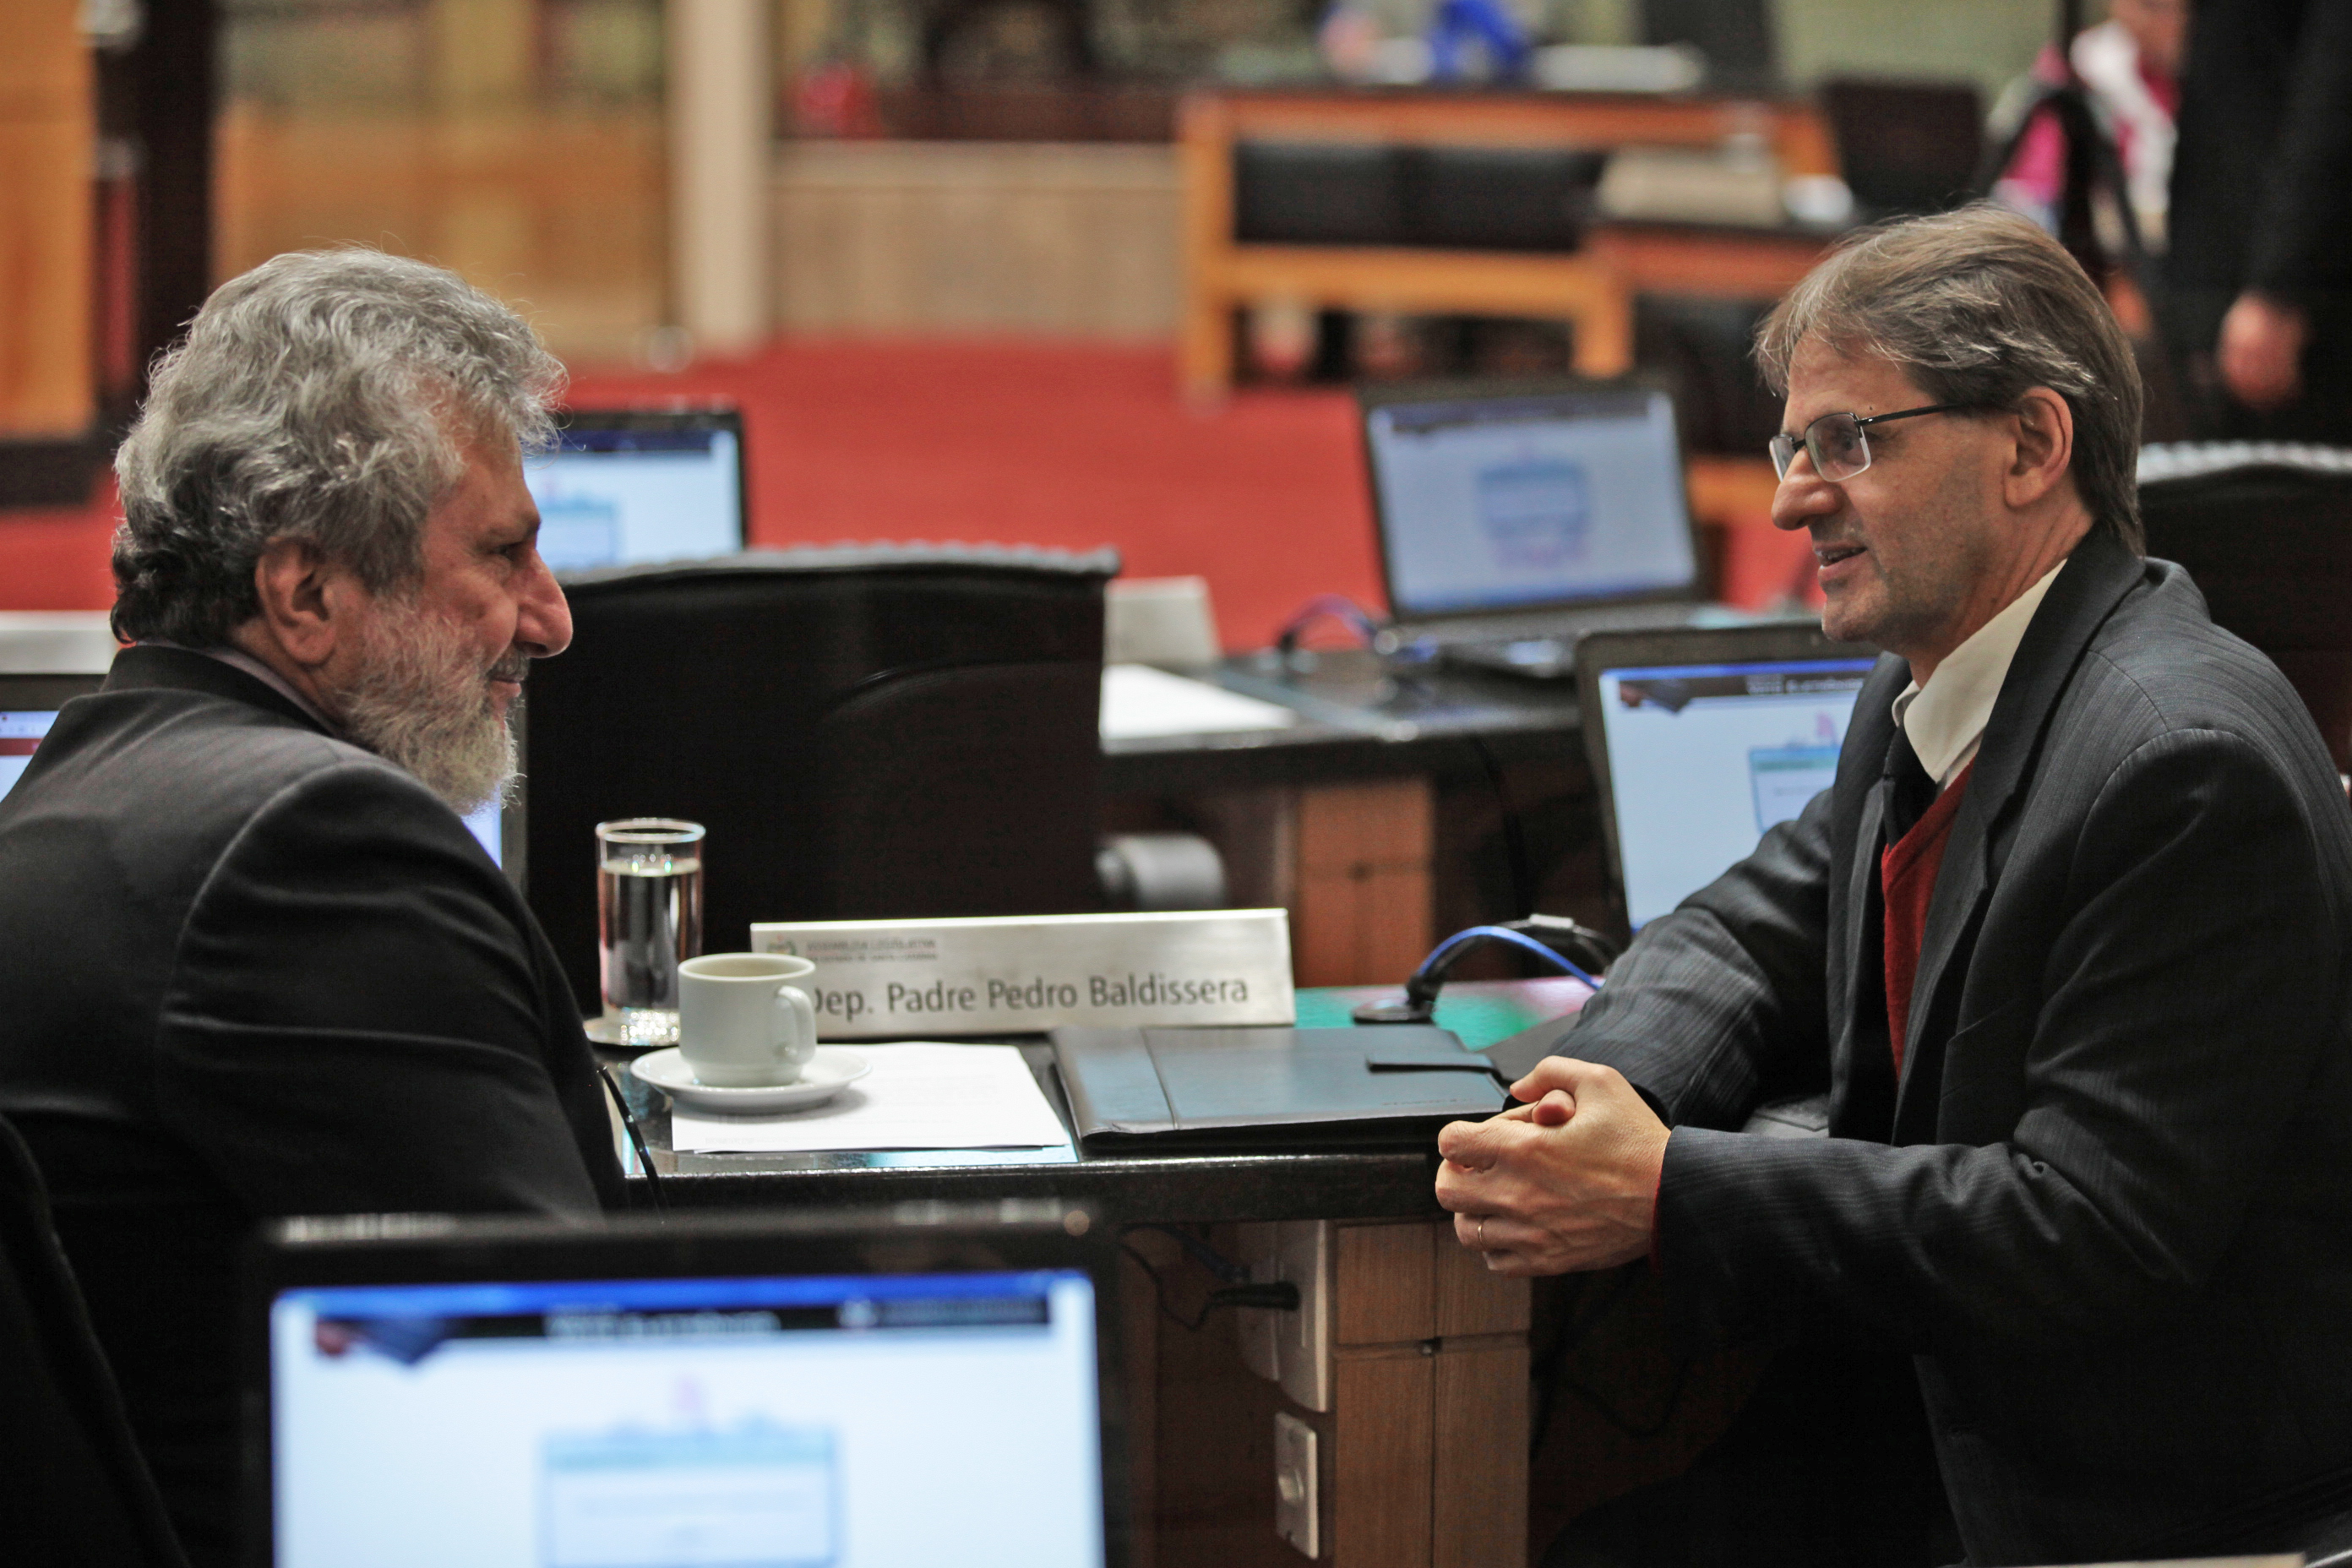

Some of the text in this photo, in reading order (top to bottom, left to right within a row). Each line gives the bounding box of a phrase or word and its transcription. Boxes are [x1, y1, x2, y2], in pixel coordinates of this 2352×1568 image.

[888, 979, 976, 1013] Padre
[988, 976, 1078, 1010] Pedro
[1089, 972, 1249, 1007] Baldissera
